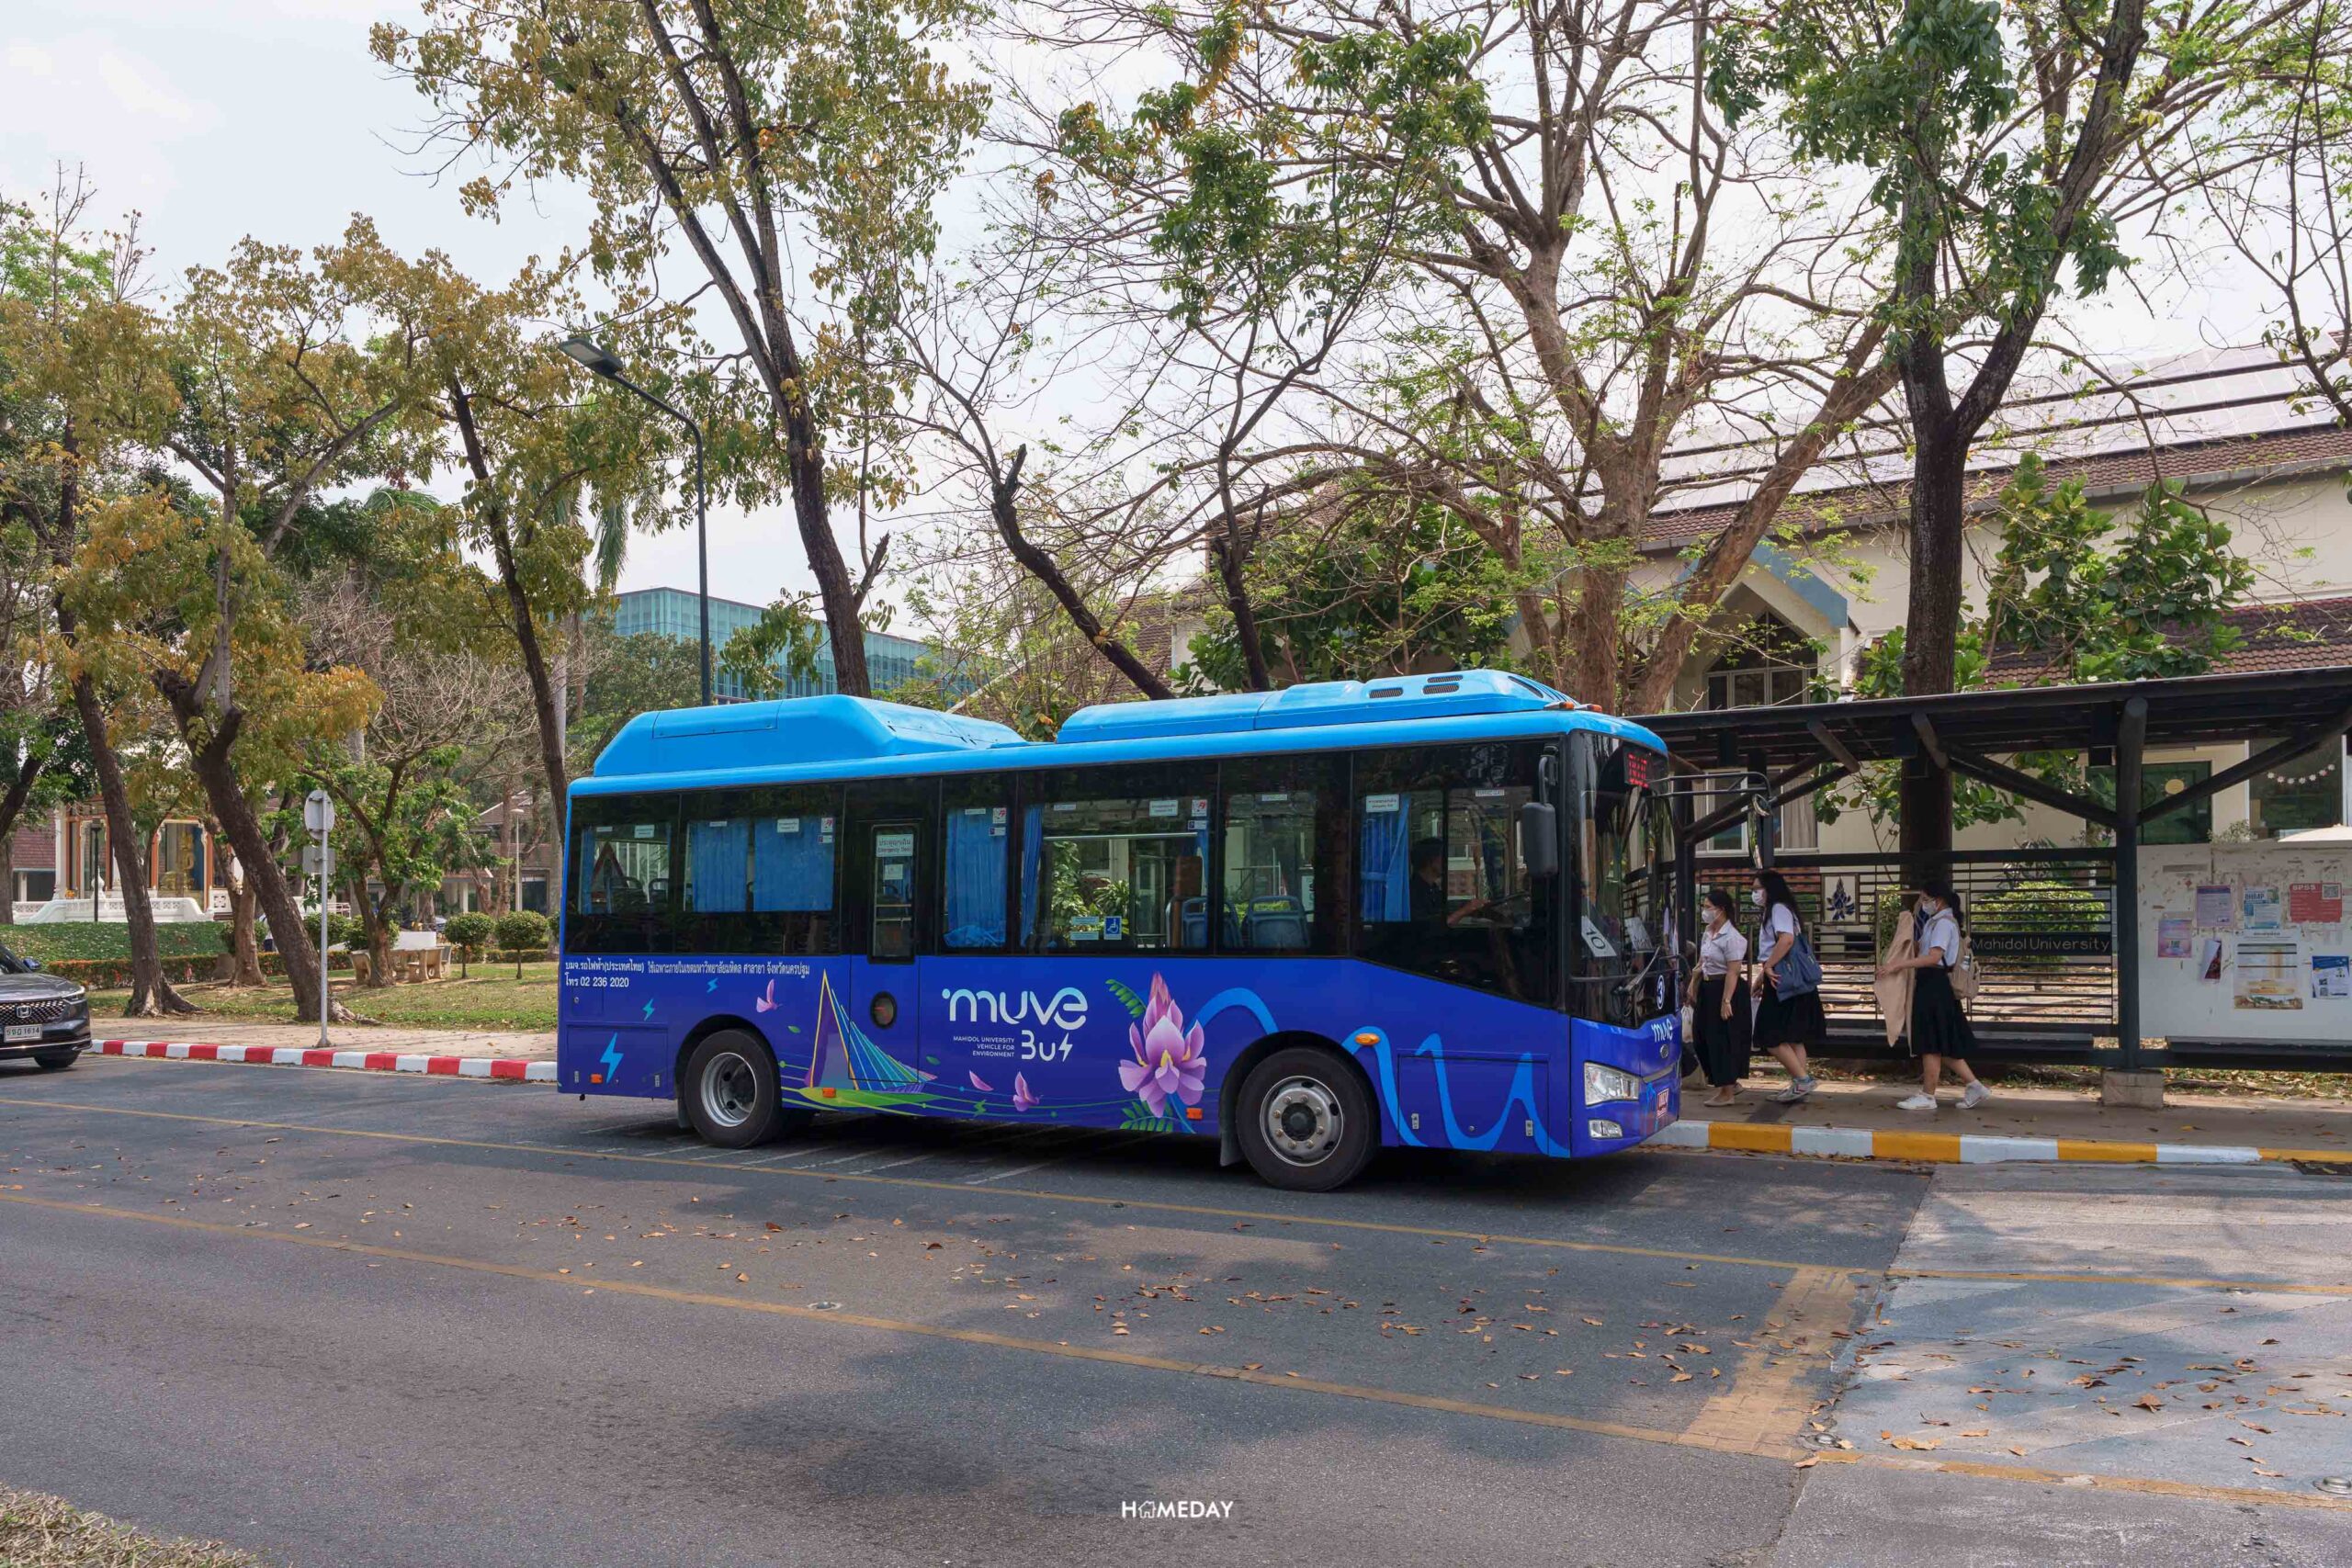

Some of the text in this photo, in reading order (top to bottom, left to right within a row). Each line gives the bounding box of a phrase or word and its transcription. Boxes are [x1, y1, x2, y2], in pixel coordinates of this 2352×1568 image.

[1972, 937, 2110, 953] Mahidol University
[564, 972, 630, 988] โทร 02 236 2020
[942, 987, 1089, 1031] muve
